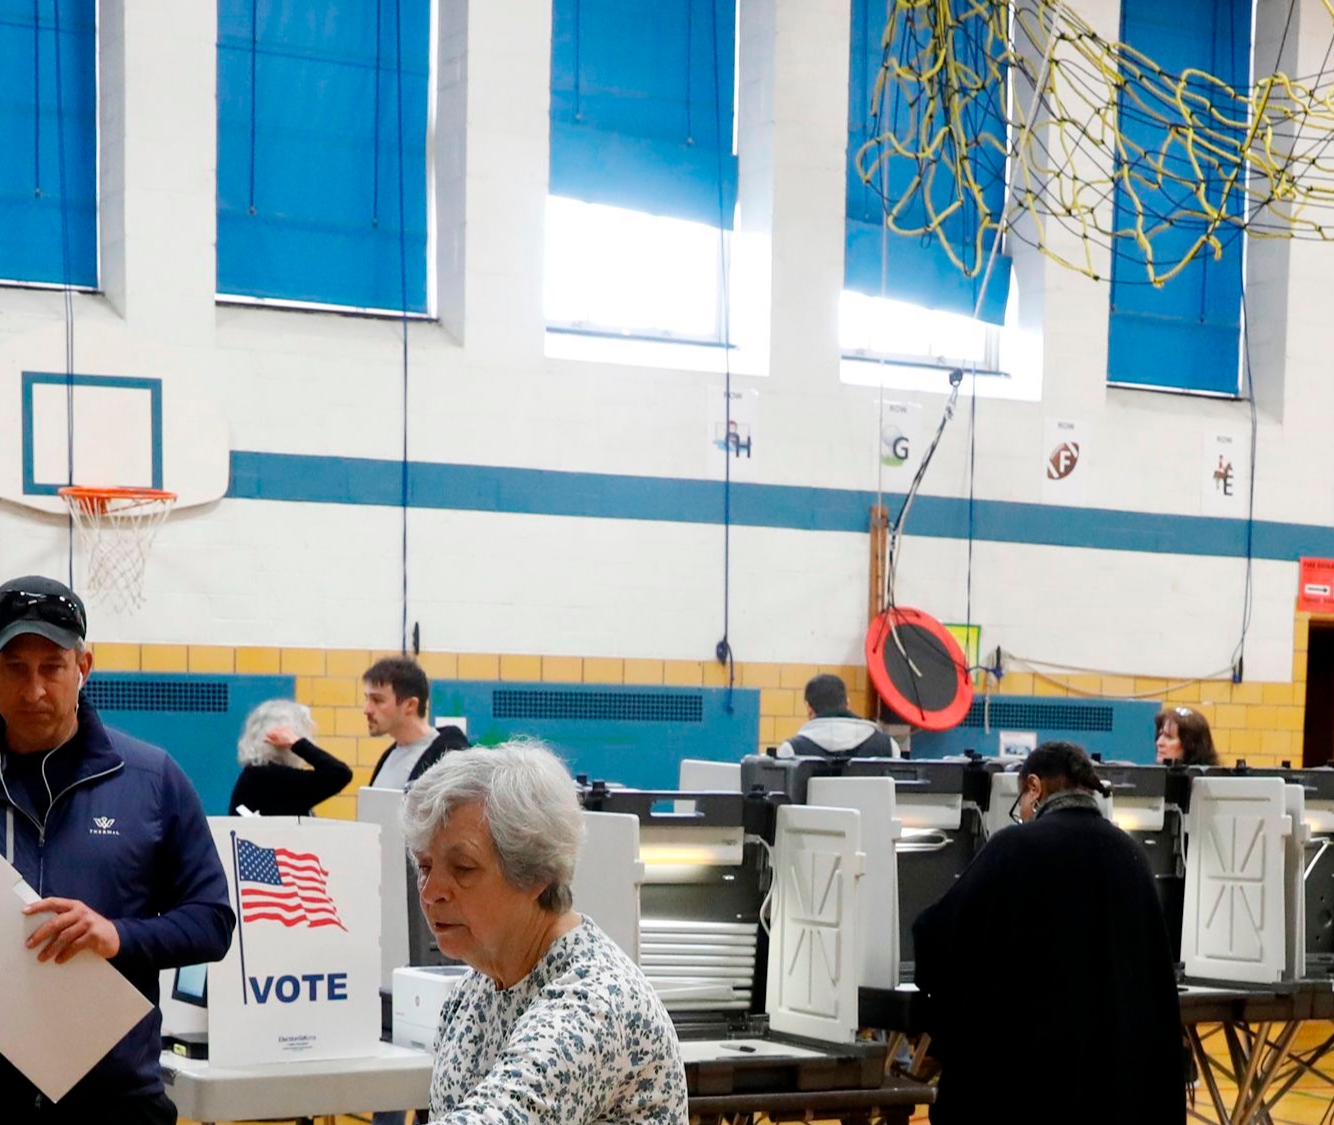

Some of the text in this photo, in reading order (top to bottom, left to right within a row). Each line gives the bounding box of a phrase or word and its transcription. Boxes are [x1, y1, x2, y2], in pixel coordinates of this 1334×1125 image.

[736, 435, 751, 458] H
[893, 436, 909, 460] G
[1059, 450, 1072, 473] F
[1223, 475, 1234, 496] E
[249, 973, 348, 1004] VOTE
